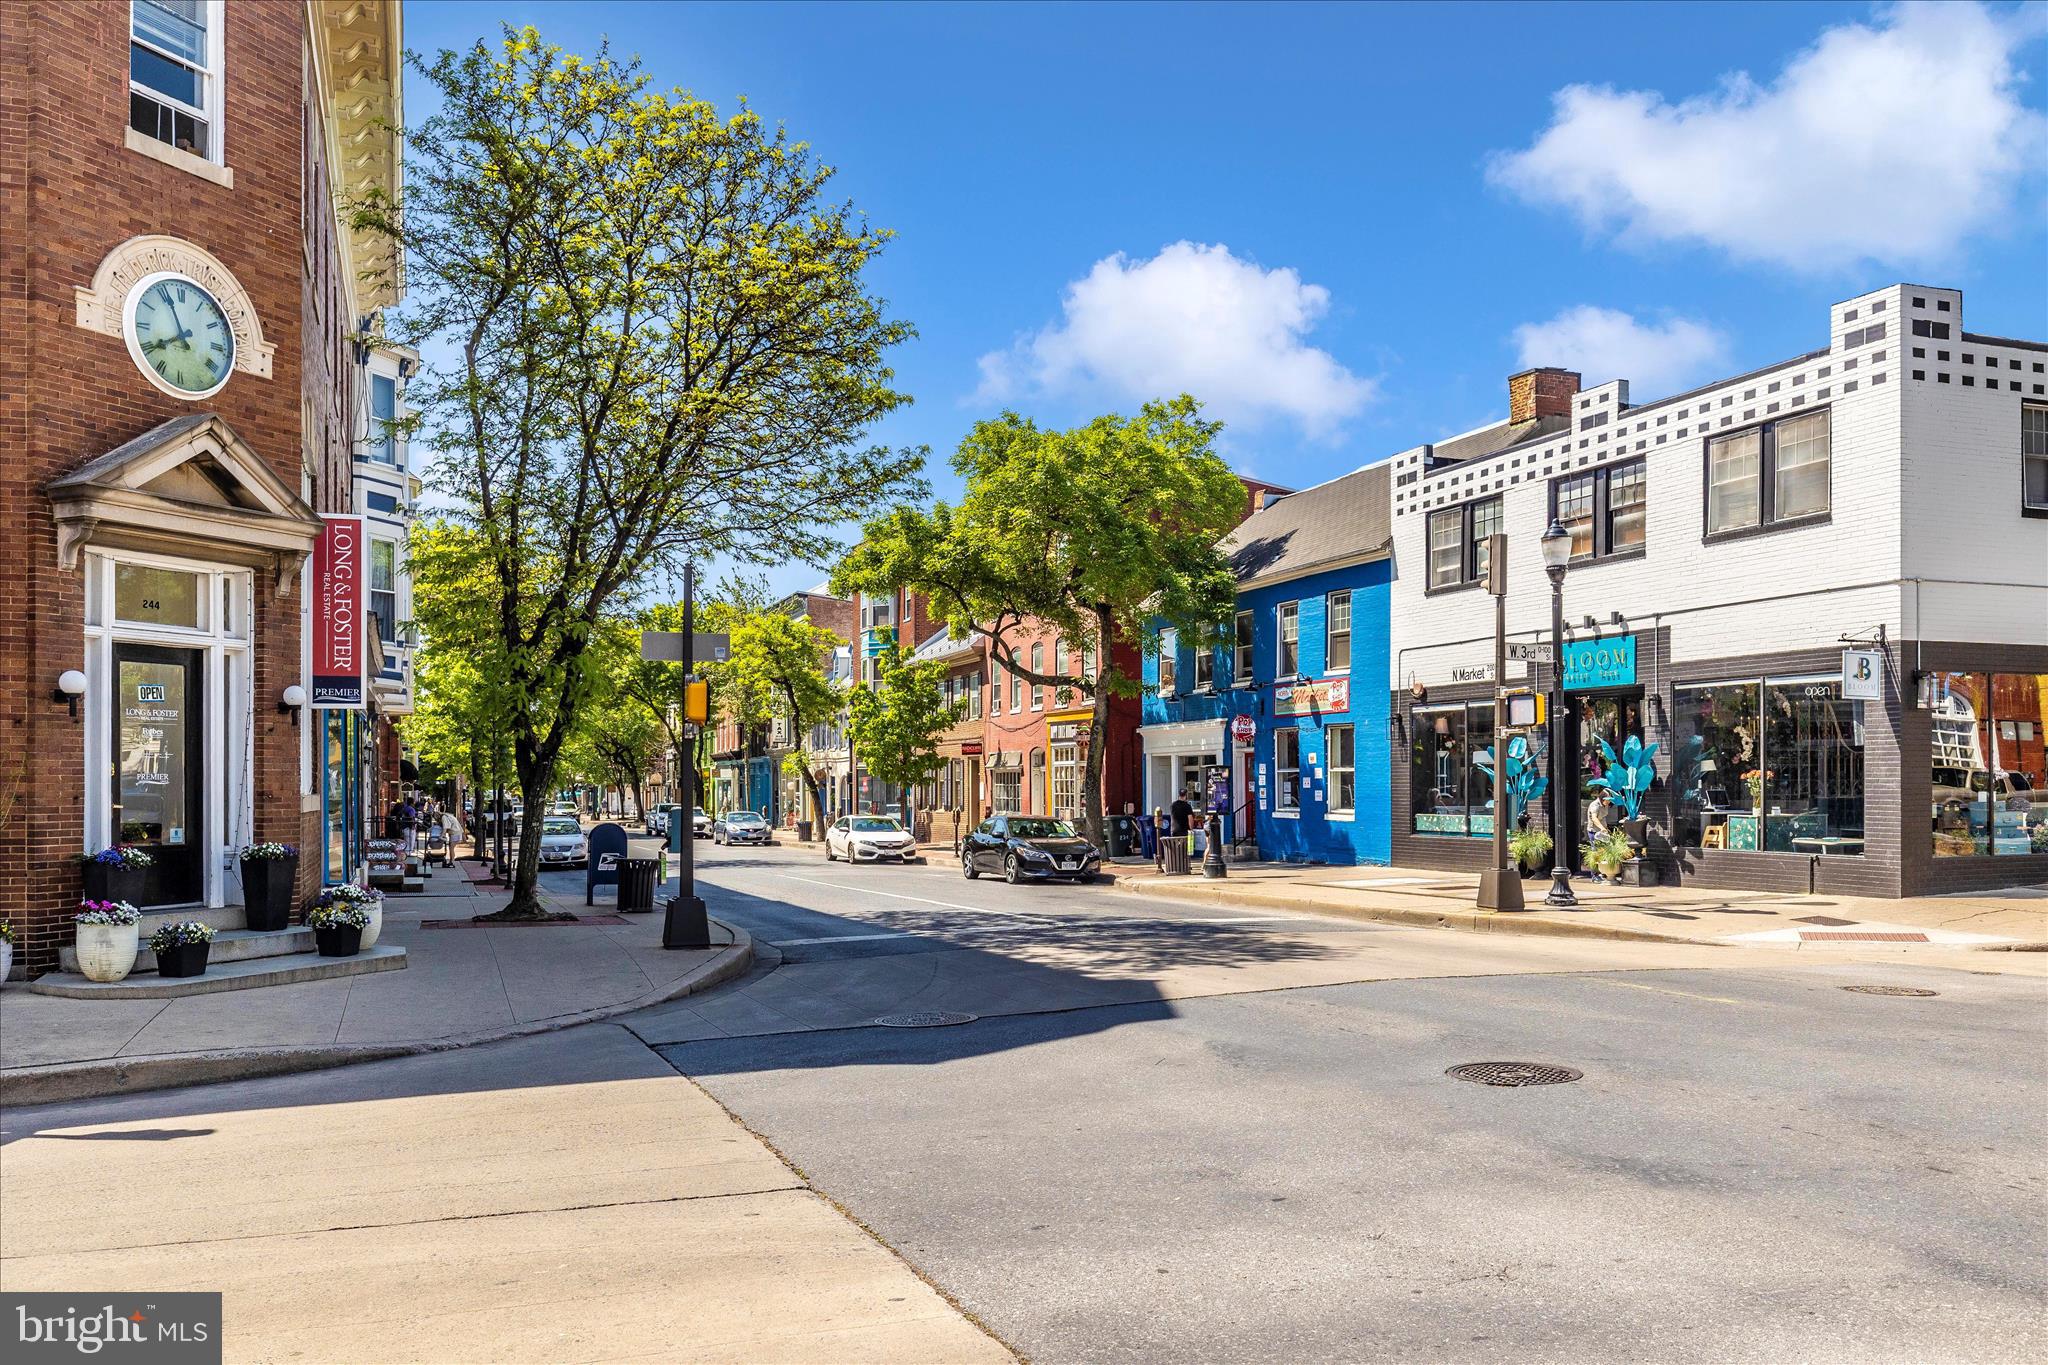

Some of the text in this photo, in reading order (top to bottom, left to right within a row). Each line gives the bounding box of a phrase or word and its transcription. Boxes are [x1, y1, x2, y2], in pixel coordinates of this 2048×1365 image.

[111, 250, 177, 298] FREDERICK
[223, 298, 251, 372] COMPANY
[323, 572, 331, 620] REAL ESTATE
[334, 524, 352, 669] LONG & FOSTER
[143, 599, 160, 610] 244
[1521, 646, 1536, 659] 3rd
[1562, 648, 1626, 671] LOOM
[1459, 668, 1486, 681] Market
[140, 686, 163, 700] OPEN
[315, 687, 361, 697] PREMIER
[1805, 687, 1830, 698] open
[126, 708, 146, 716] LONG
[153, 709, 178, 717] FOSTER
[136, 773, 169, 781] PREMIER
